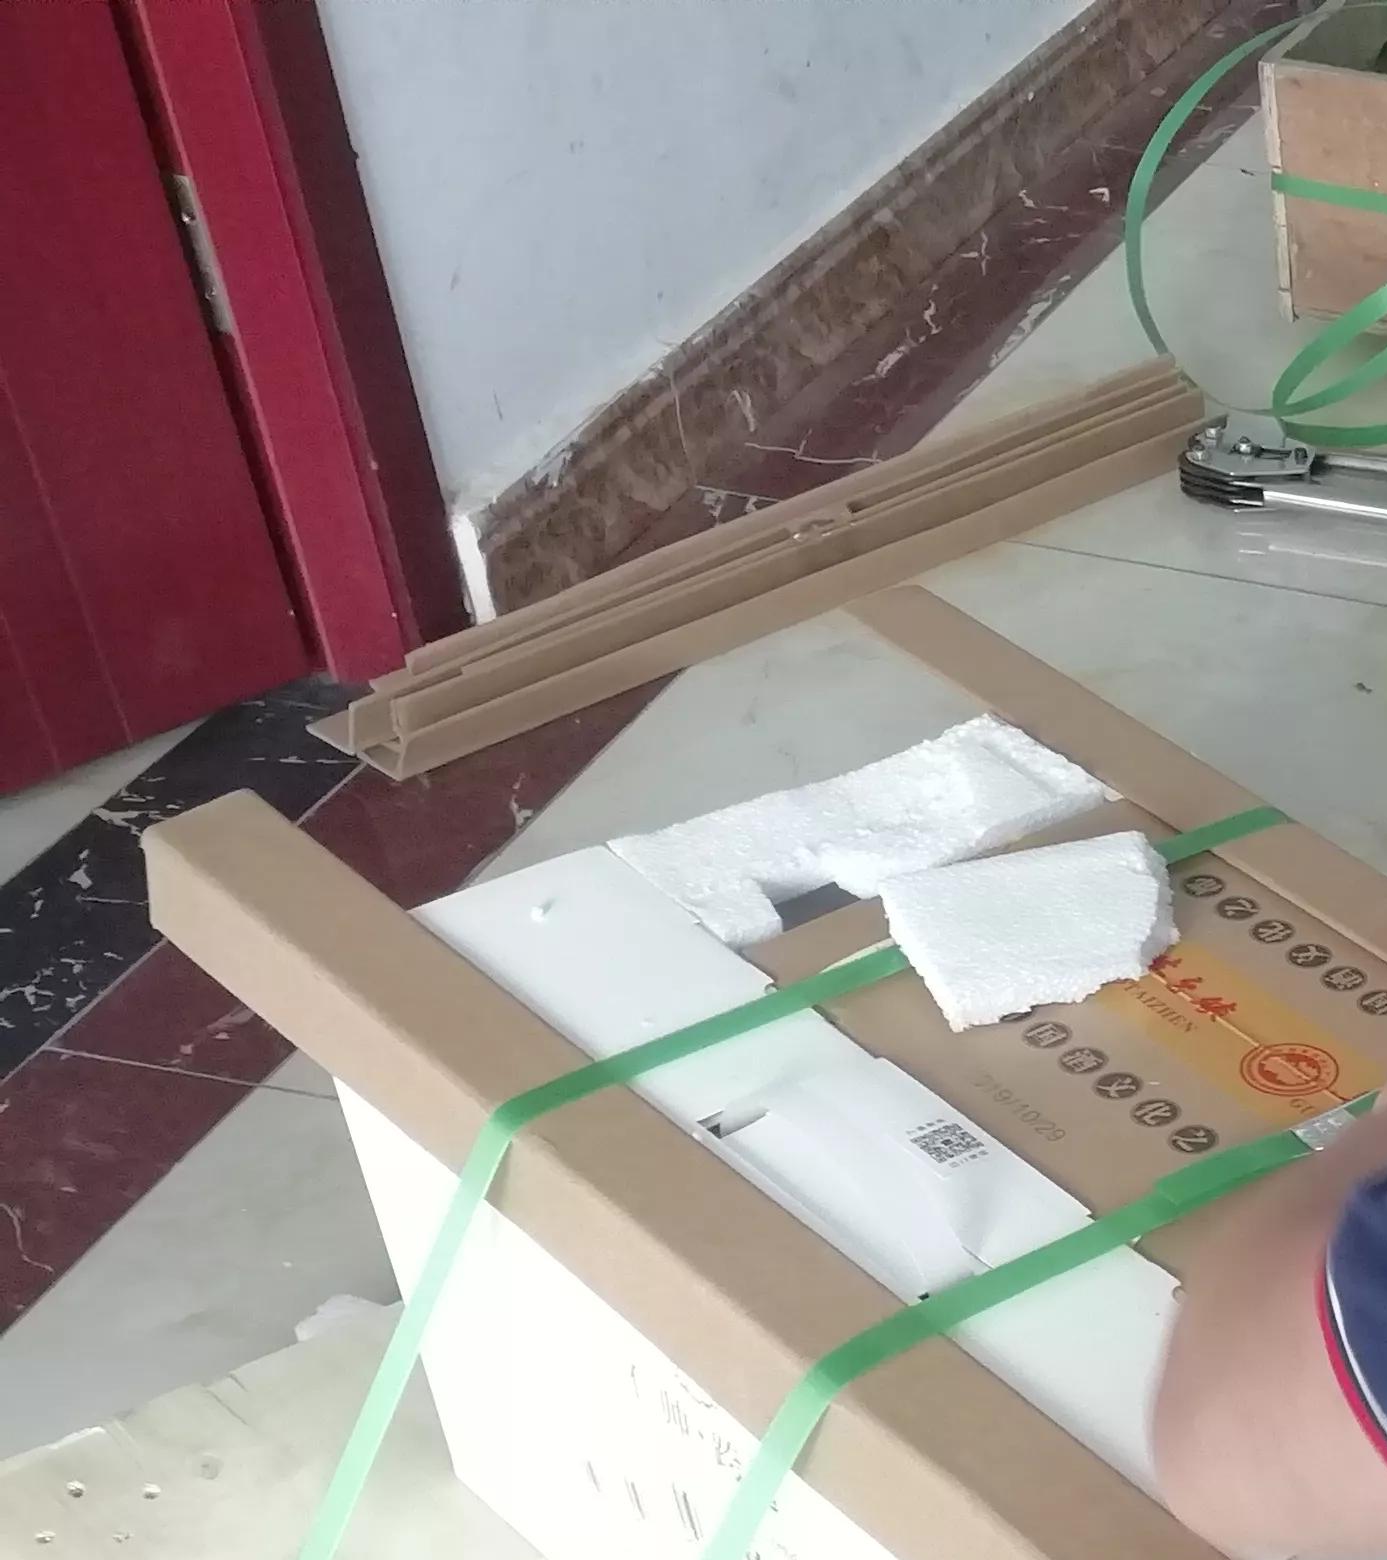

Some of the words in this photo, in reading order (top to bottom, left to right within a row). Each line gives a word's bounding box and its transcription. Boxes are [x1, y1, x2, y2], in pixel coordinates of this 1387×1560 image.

[1002, 1002, 1217, 1152] 国酒文化之
